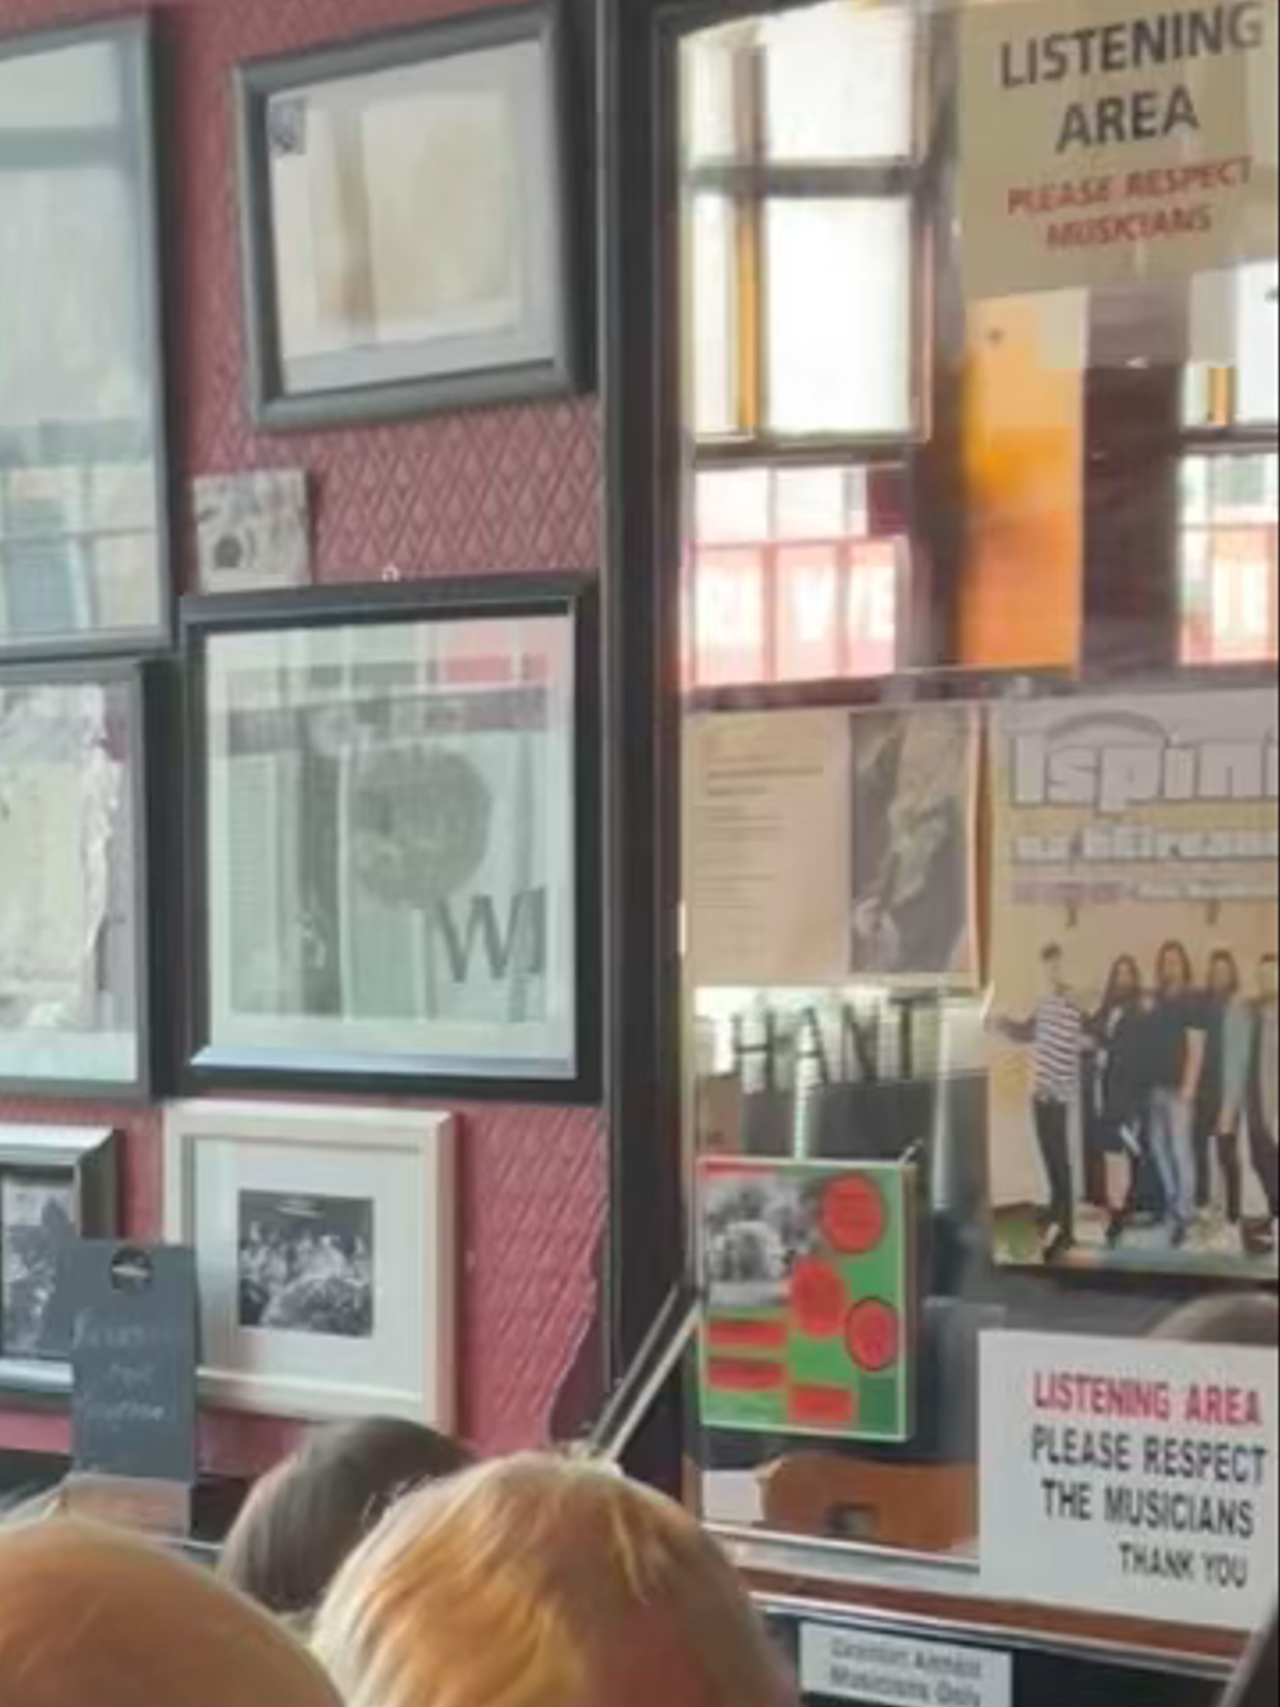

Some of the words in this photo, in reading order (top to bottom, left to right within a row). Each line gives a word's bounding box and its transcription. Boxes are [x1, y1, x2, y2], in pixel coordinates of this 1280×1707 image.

[1055, 82, 1200, 155] AREA
[1008, 175, 1111, 216] PLEASE
[1125, 154, 1253, 199] RESPECT
[1046, 204, 1213, 249] MUSICIANS
[1033, 1371, 1170, 1421] LISTENING
[1185, 1384, 1262, 1426] AREA
[1031, 1423, 1131, 1473] PLEASE
[1143, 1436, 1268, 1488] RESPECT
[1042, 1477, 1093, 1522] THE
[1104, 1486, 1255, 1540] MUSICIANS
[1119, 1541, 1196, 1582] THANK
[1201, 1551, 1249, 1590] YOU
